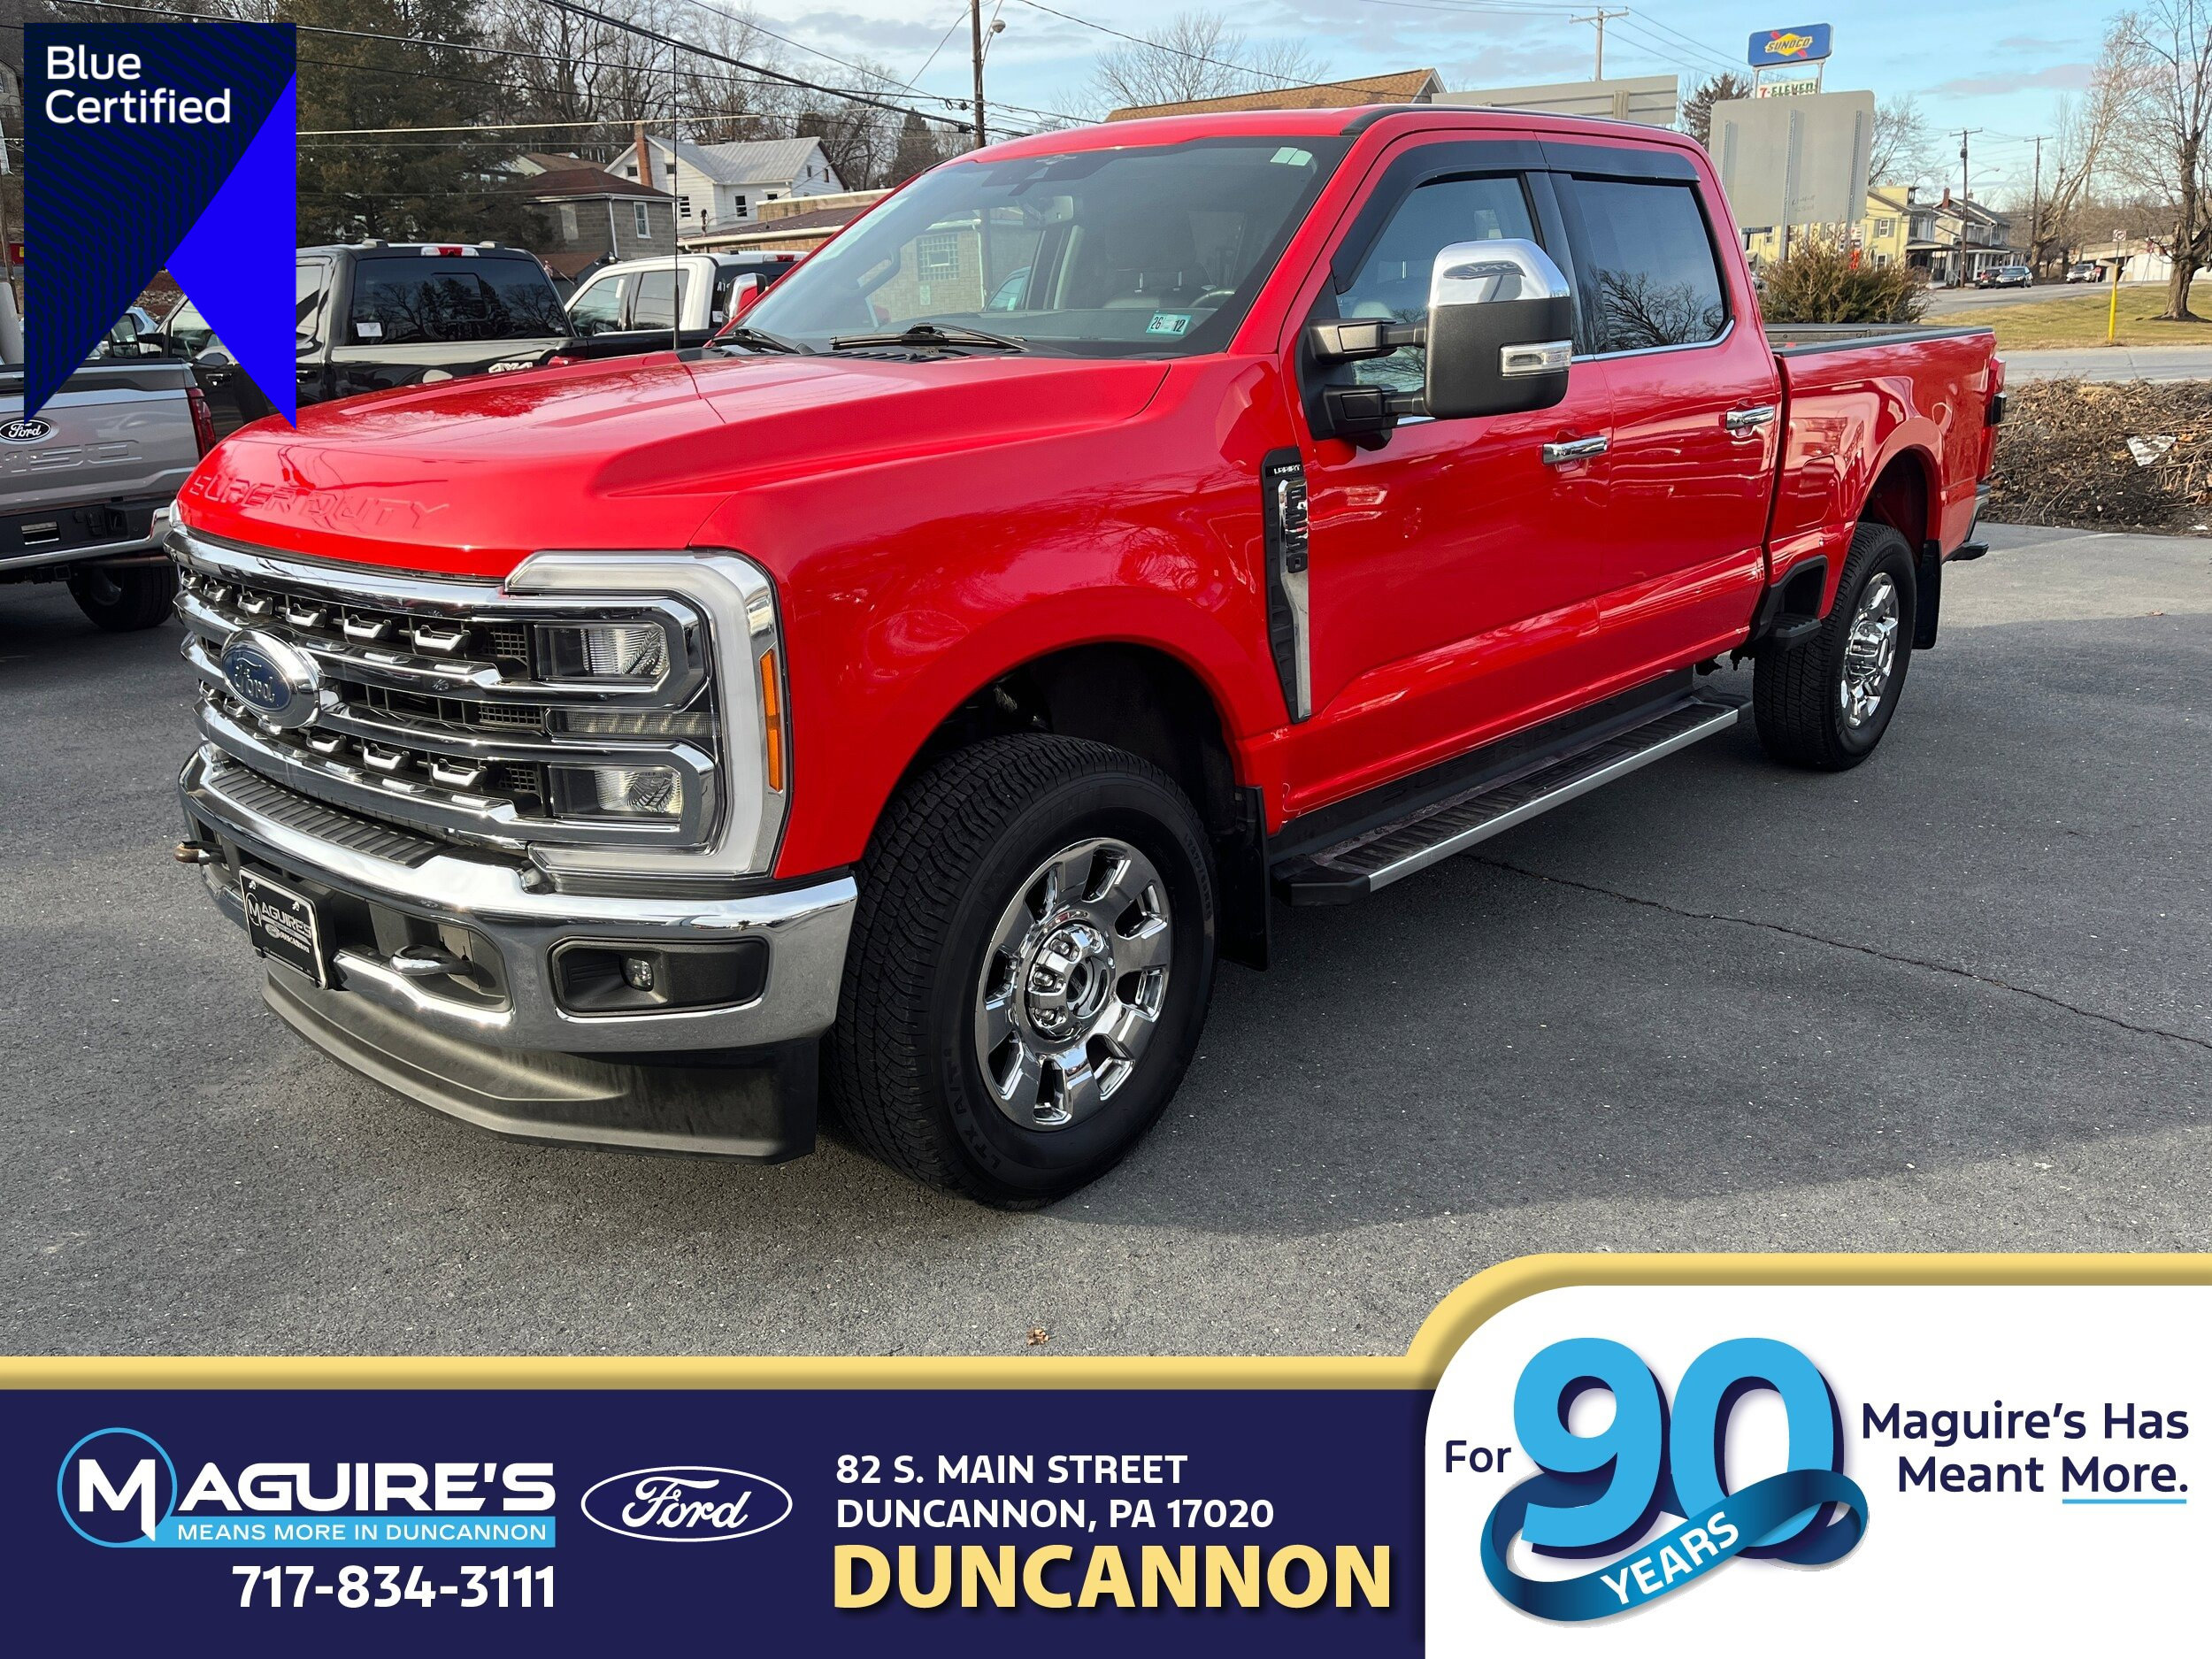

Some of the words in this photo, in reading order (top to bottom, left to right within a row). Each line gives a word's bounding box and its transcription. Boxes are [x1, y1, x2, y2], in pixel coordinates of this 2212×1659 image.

[1767, 37, 1811, 51] SUNOCO
[1150, 316, 1164, 330] 26
[1172, 319, 1186, 333] 12
[8, 422, 42, 438] Ford
[188, 474, 302, 514] SUPER
[304, 491, 450, 530] DUTY
[233, 657, 275, 703] Ford
